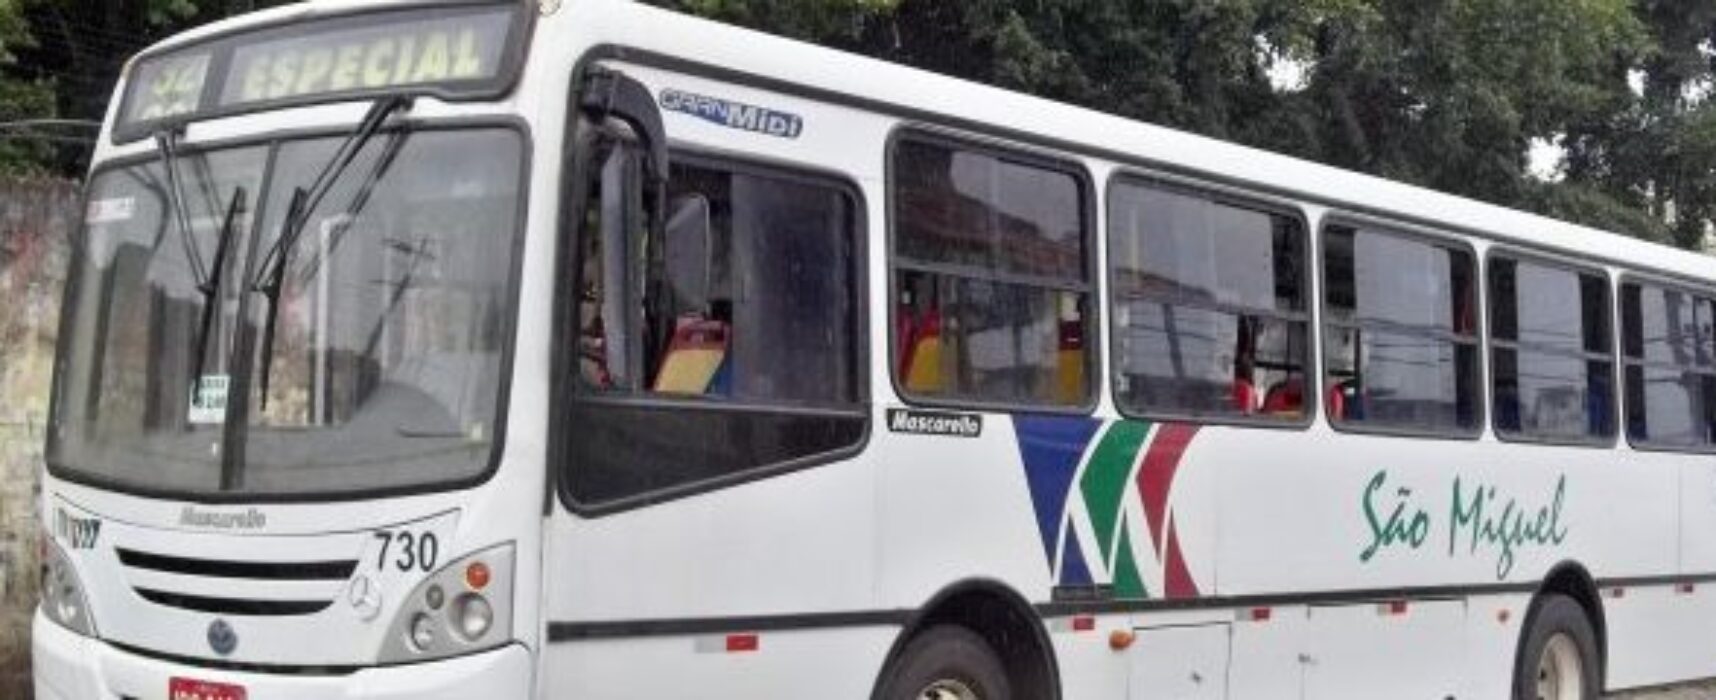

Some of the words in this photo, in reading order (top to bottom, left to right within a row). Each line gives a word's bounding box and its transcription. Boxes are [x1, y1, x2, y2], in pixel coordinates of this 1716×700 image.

[242, 28, 480, 100] ESPECIAL
[374, 531, 439, 572] 730
[1359, 469, 1430, 562] São
[1449, 472, 1568, 580] Miguel
